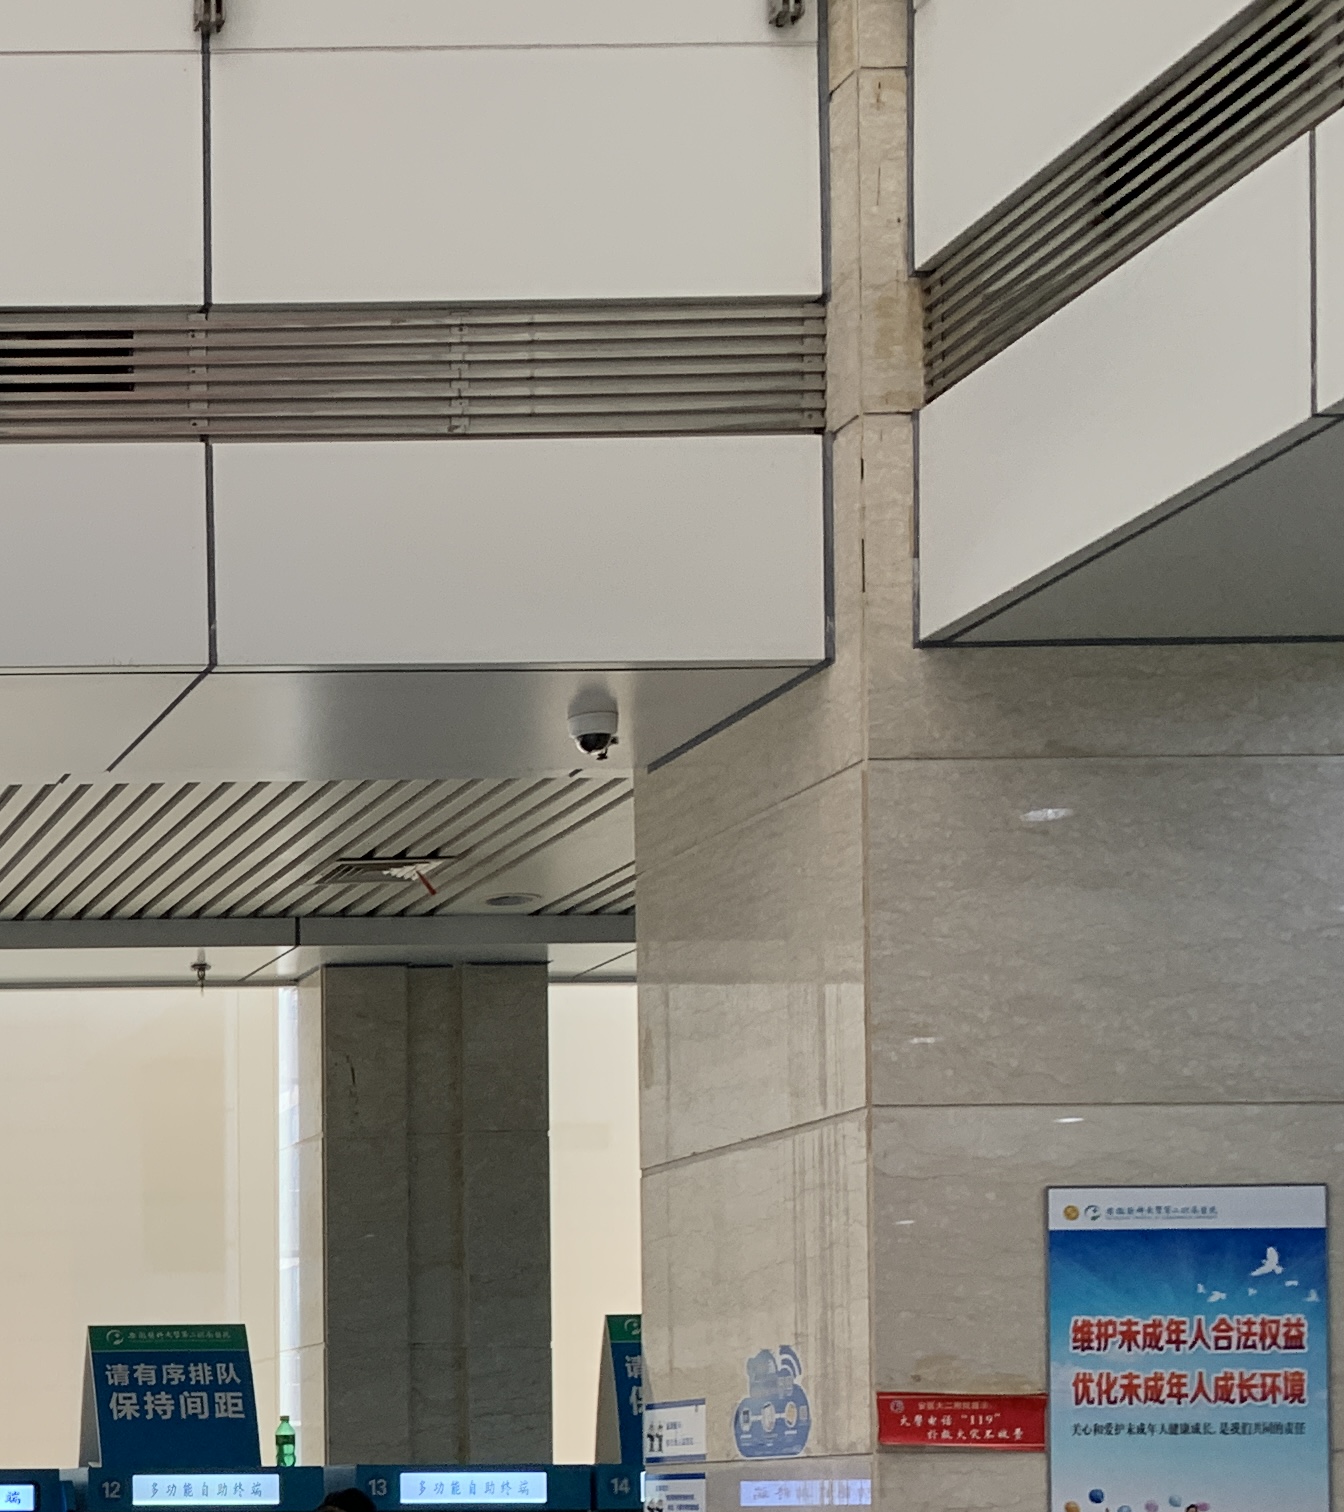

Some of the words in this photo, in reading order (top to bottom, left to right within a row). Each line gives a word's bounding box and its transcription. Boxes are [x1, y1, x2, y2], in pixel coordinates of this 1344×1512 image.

[1070, 1316, 1308, 1353] 维护未成年人合法权益
[105, 1363, 241, 1386] 请有序排队
[1071, 1370, 1308, 1407] 优化未成年人成长环境
[109, 1391, 246, 1420] 保持间距
[102, 1481, 121, 1498] 12
[150, 1481, 263, 1498] 多功能自助终端
[368, 1479, 387, 1496] 13
[418, 1480, 530, 1497] 多功能自助终端
[611, 1478, 630, 1494] 14
